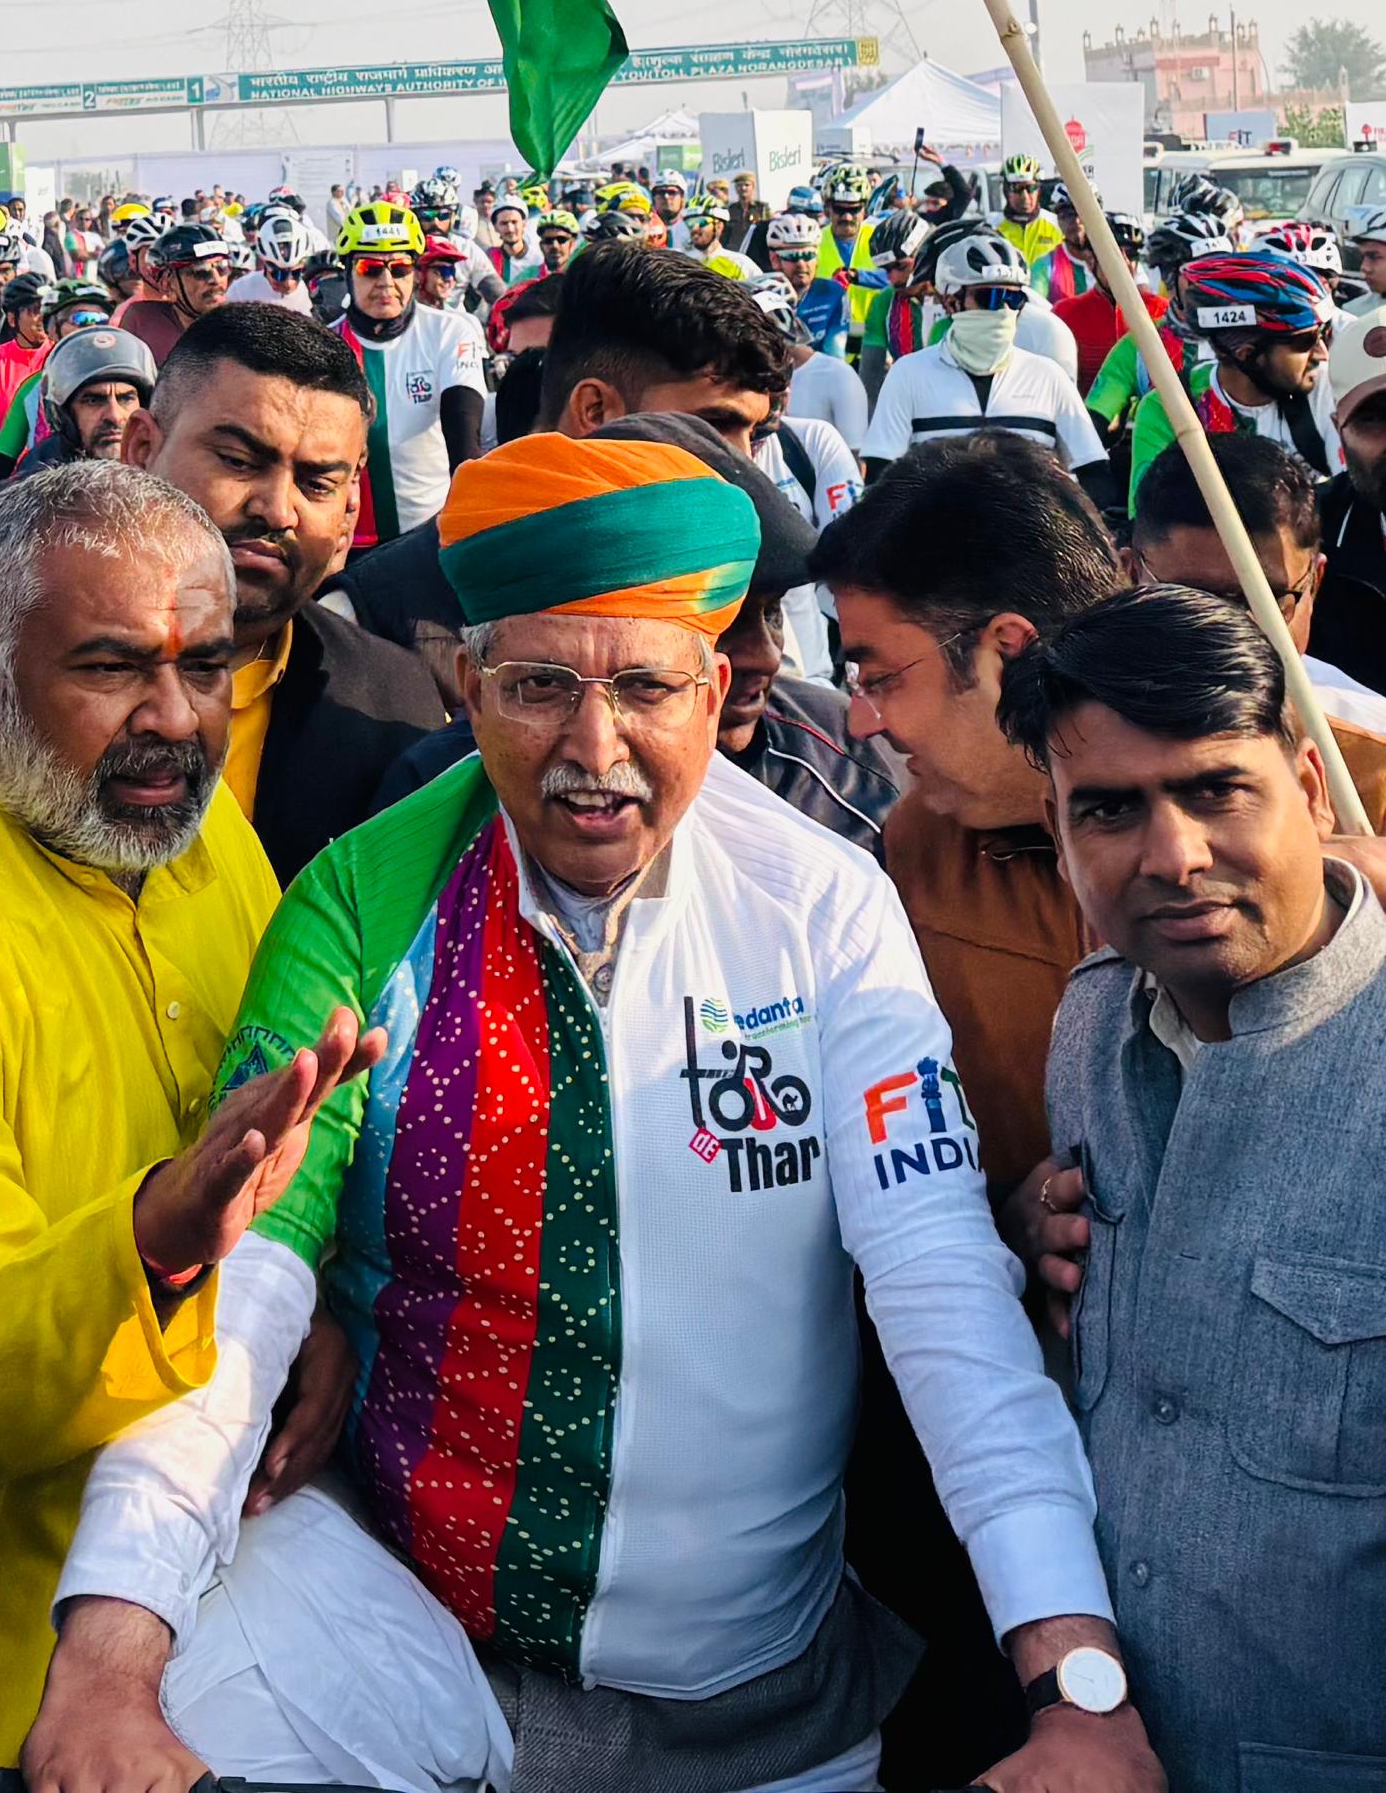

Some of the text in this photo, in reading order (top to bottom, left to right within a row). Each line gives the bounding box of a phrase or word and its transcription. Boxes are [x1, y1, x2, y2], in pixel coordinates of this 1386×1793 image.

[691, 65, 735, 76] PLAZA
[84, 91, 95, 108] 2
[191, 83, 200, 97] 1
[250, 87, 318, 100] NATIONAL
[322, 83, 392, 96] HIGHWAYS
[396, 79, 475, 92] AUTHORITY
[477, 78, 496, 87] OF
[714, 147, 745, 174] Bisleri
[769, 145, 801, 172] Bisleri
[1214, 310, 1247, 324] 1424
[734, 997, 804, 1030] edanta
[720, 1134, 821, 1193] Thar
